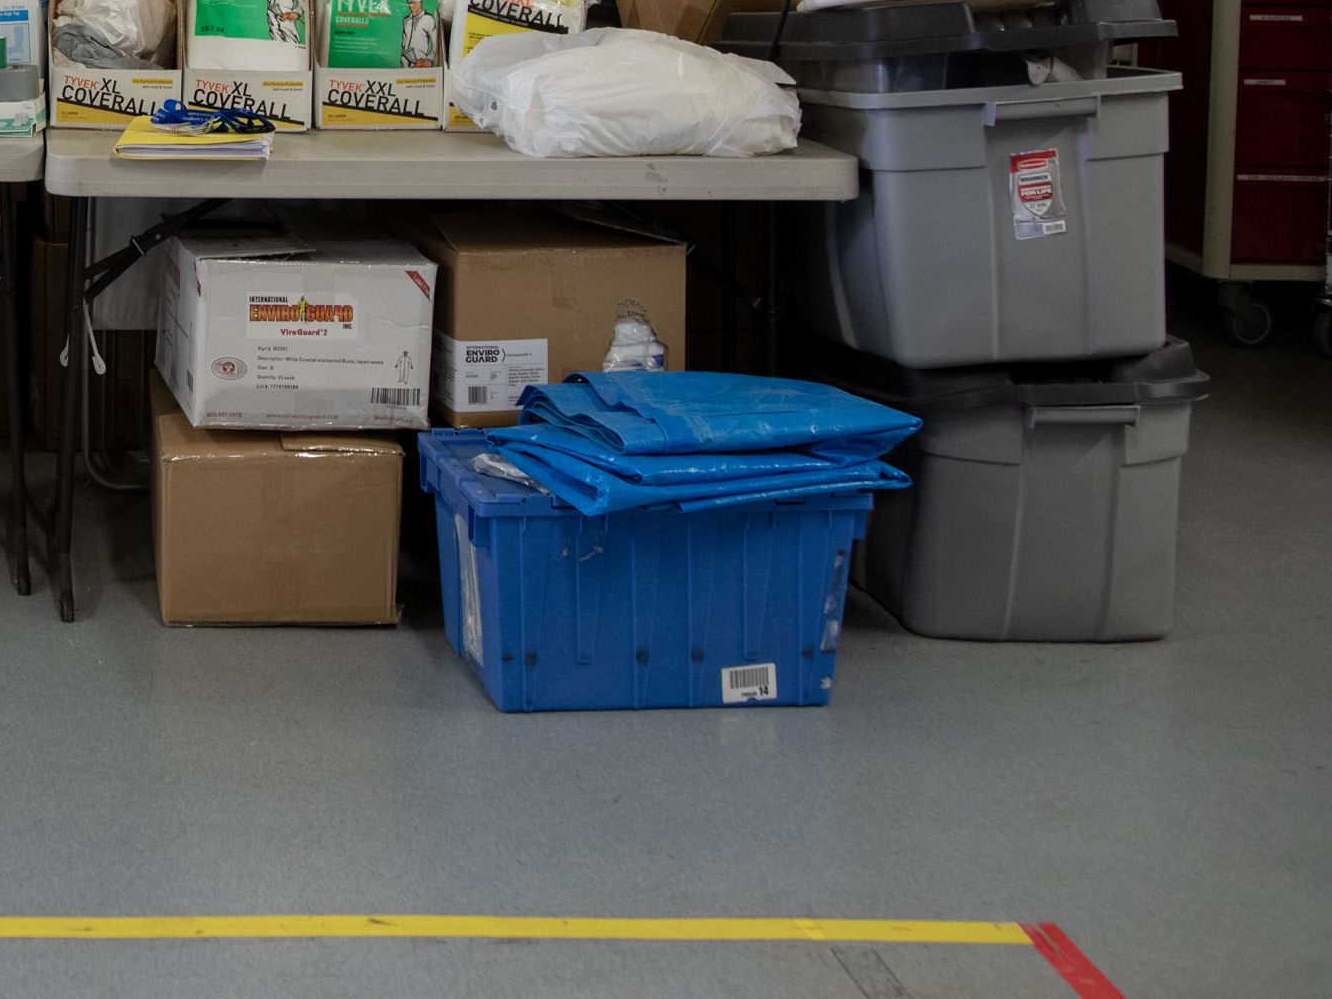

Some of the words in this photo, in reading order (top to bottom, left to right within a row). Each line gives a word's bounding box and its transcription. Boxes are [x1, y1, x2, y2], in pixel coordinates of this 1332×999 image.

[336, 16, 369, 24] COVERALLS
[64, 75, 98, 90] TYVEK
[100, 78, 121, 94] XL
[196, 79, 228, 93] TYVEK
[231, 81, 252, 97] XL
[329, 80, 362, 92] TYVEK
[365, 80, 396, 97] XXL
[62, 85, 156, 116] COVERALL
[194, 88, 290, 120] COVERALL
[328, 89, 424, 116] COVERALL
[250, 304, 299, 322] ENVIRO
[306, 304, 353, 322] GUARD
[759, 685, 769, 696] 14
